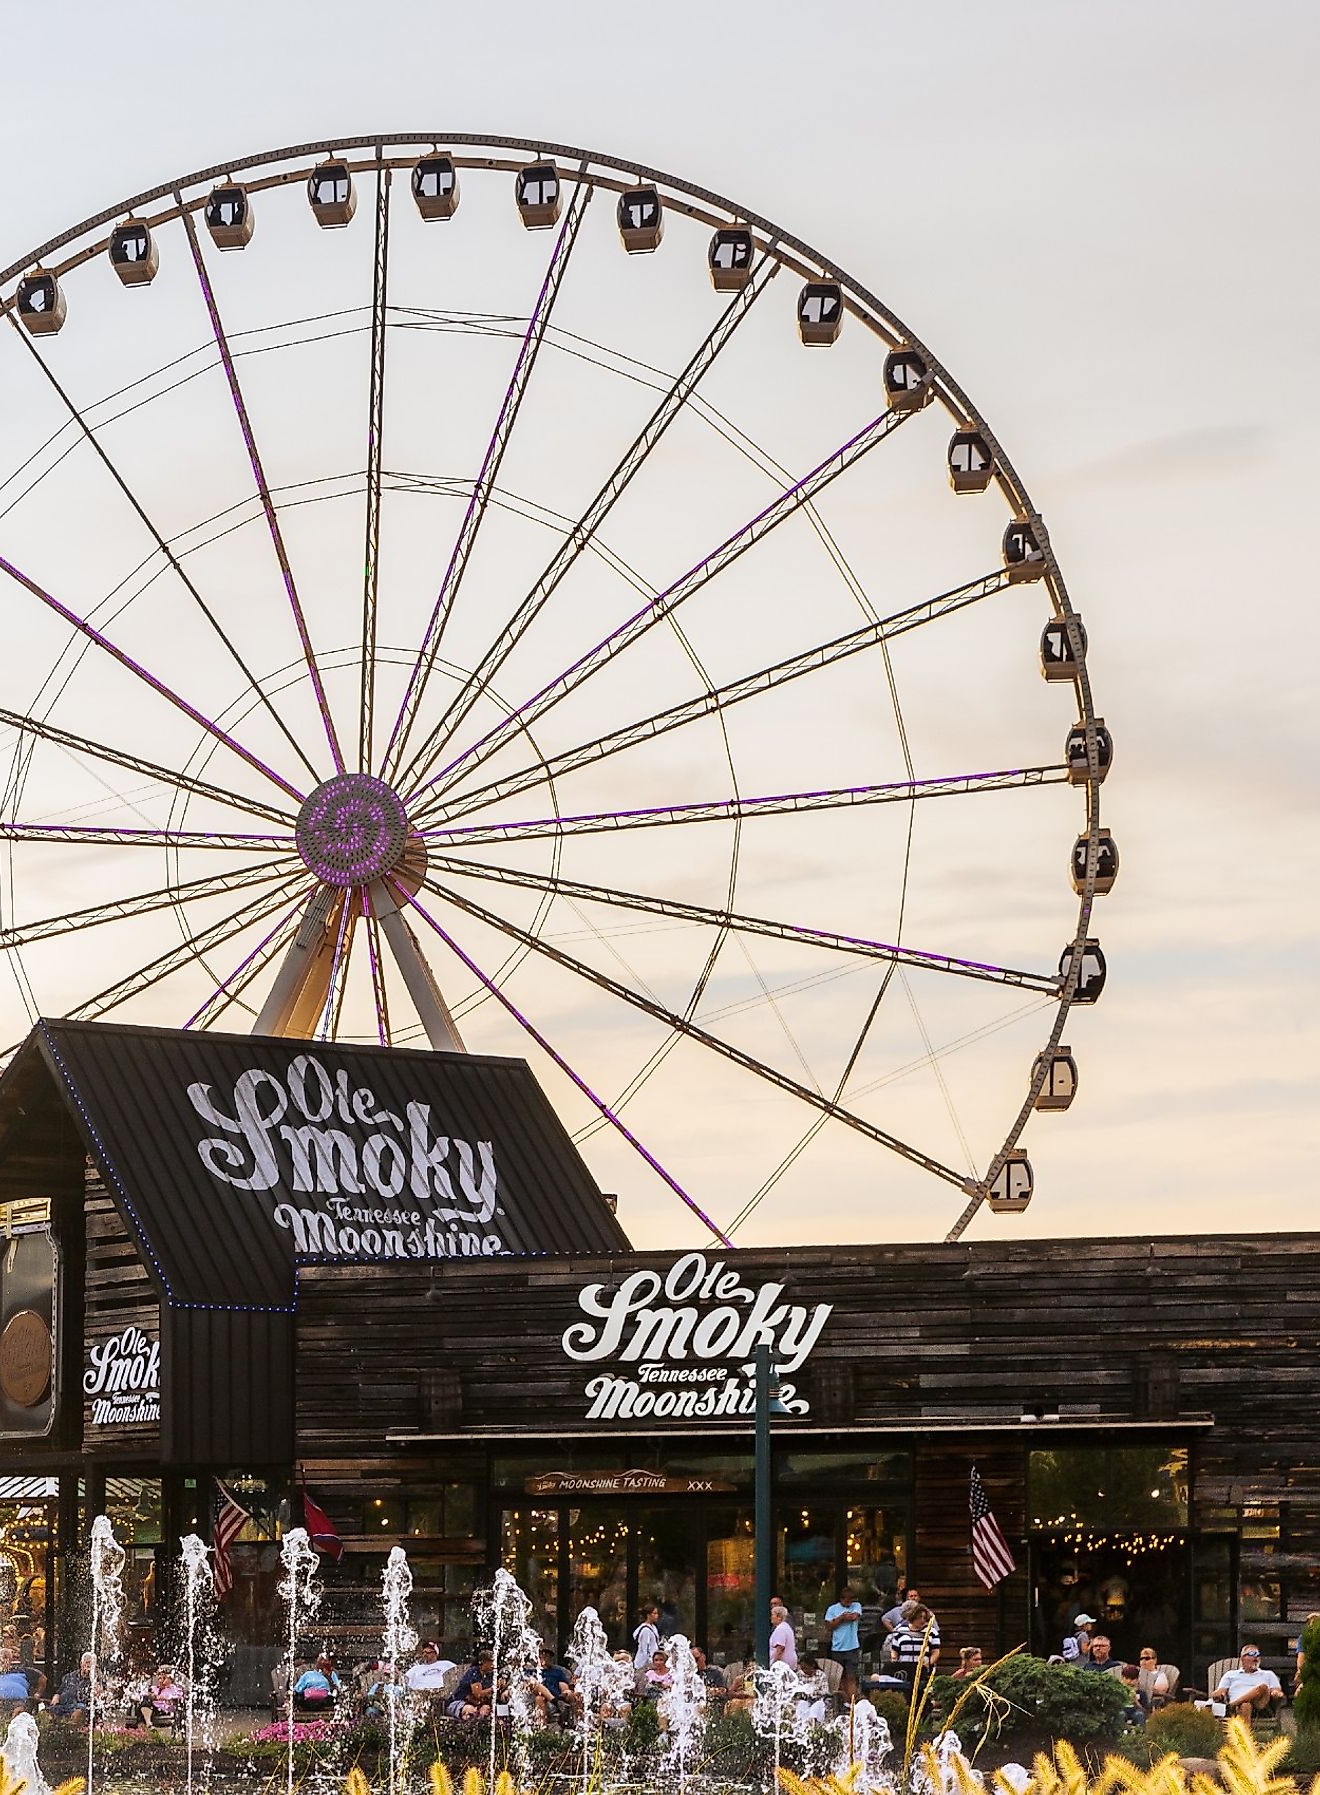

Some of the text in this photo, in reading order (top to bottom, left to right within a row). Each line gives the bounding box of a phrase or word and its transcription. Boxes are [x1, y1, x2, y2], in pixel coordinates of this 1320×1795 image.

[287, 1054, 405, 1132] Ole
[186, 1069, 498, 1224] Smoky
[273, 1203, 512, 1258] Moonshine
[326, 1197, 422, 1226] Tennessee
[665, 1252, 755, 1303] Ole
[120, 1327, 151, 1356] Ole
[562, 1270, 834, 1374] Smoky
[83, 1337, 161, 1395] Smok
[638, 1363, 727, 1384] Tennessee
[585, 1377, 810, 1419] Moonshie
[559, 1478, 620, 1490] MOONSHINE
[623, 1477, 667, 1488] TASTING
[686, 1480, 713, 1491] XXX
